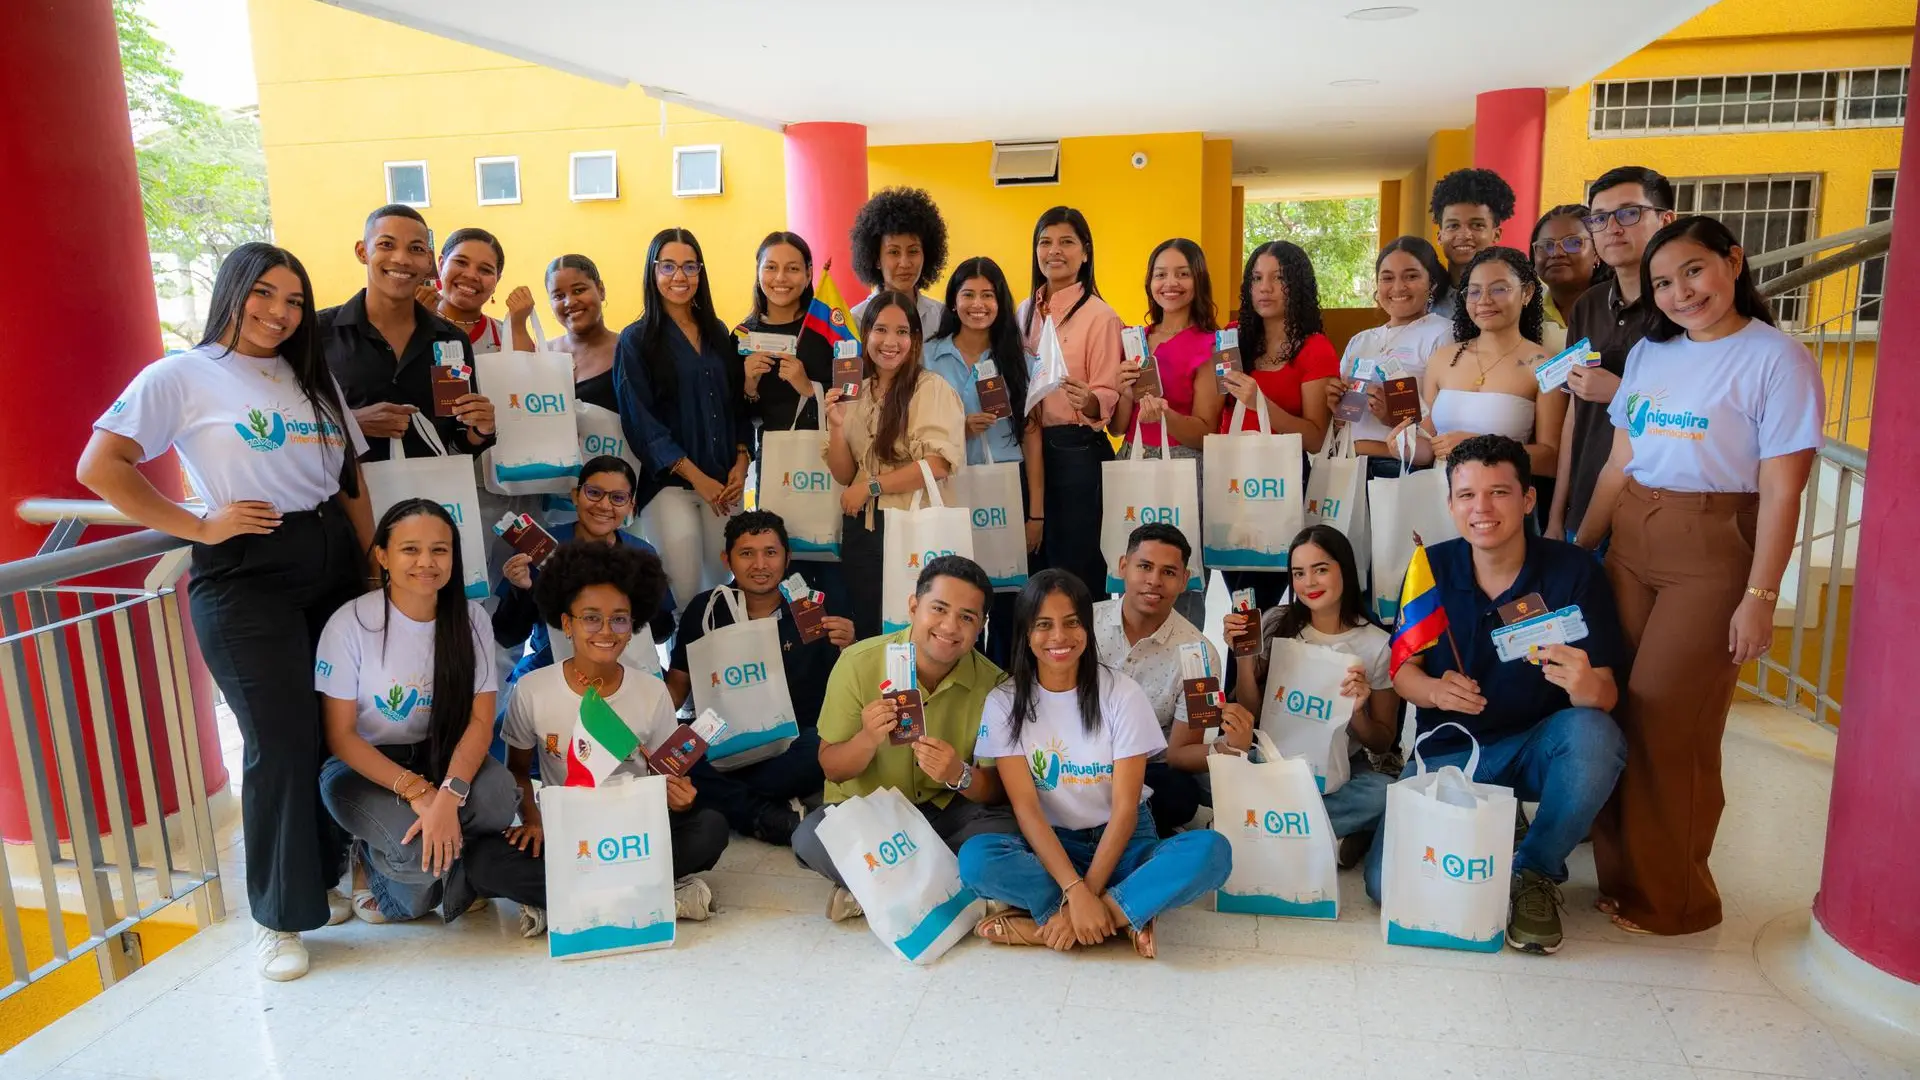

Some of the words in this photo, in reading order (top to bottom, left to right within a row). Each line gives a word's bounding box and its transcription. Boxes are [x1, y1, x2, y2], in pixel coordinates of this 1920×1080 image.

[113, 401, 126, 413] RI
[525, 393, 565, 413] ORI
[585, 434, 623, 456] ORI
[792, 471, 831, 491] ORI
[1244, 478, 1284, 498] ORI
[441, 503, 463, 523] RI
[972, 508, 1006, 527] ORI
[1140, 506, 1179, 526] ORI
[1321, 498, 1340, 517] RI
[316, 660, 333, 677] RI
[723, 662, 767, 686] ORI
[1286, 690, 1333, 720] ORI
[1264, 810, 1311, 835] ORI
[597, 832, 650, 862] ORI
[879, 829, 918, 865] ORI
[1442, 853, 1494, 881] ORI
